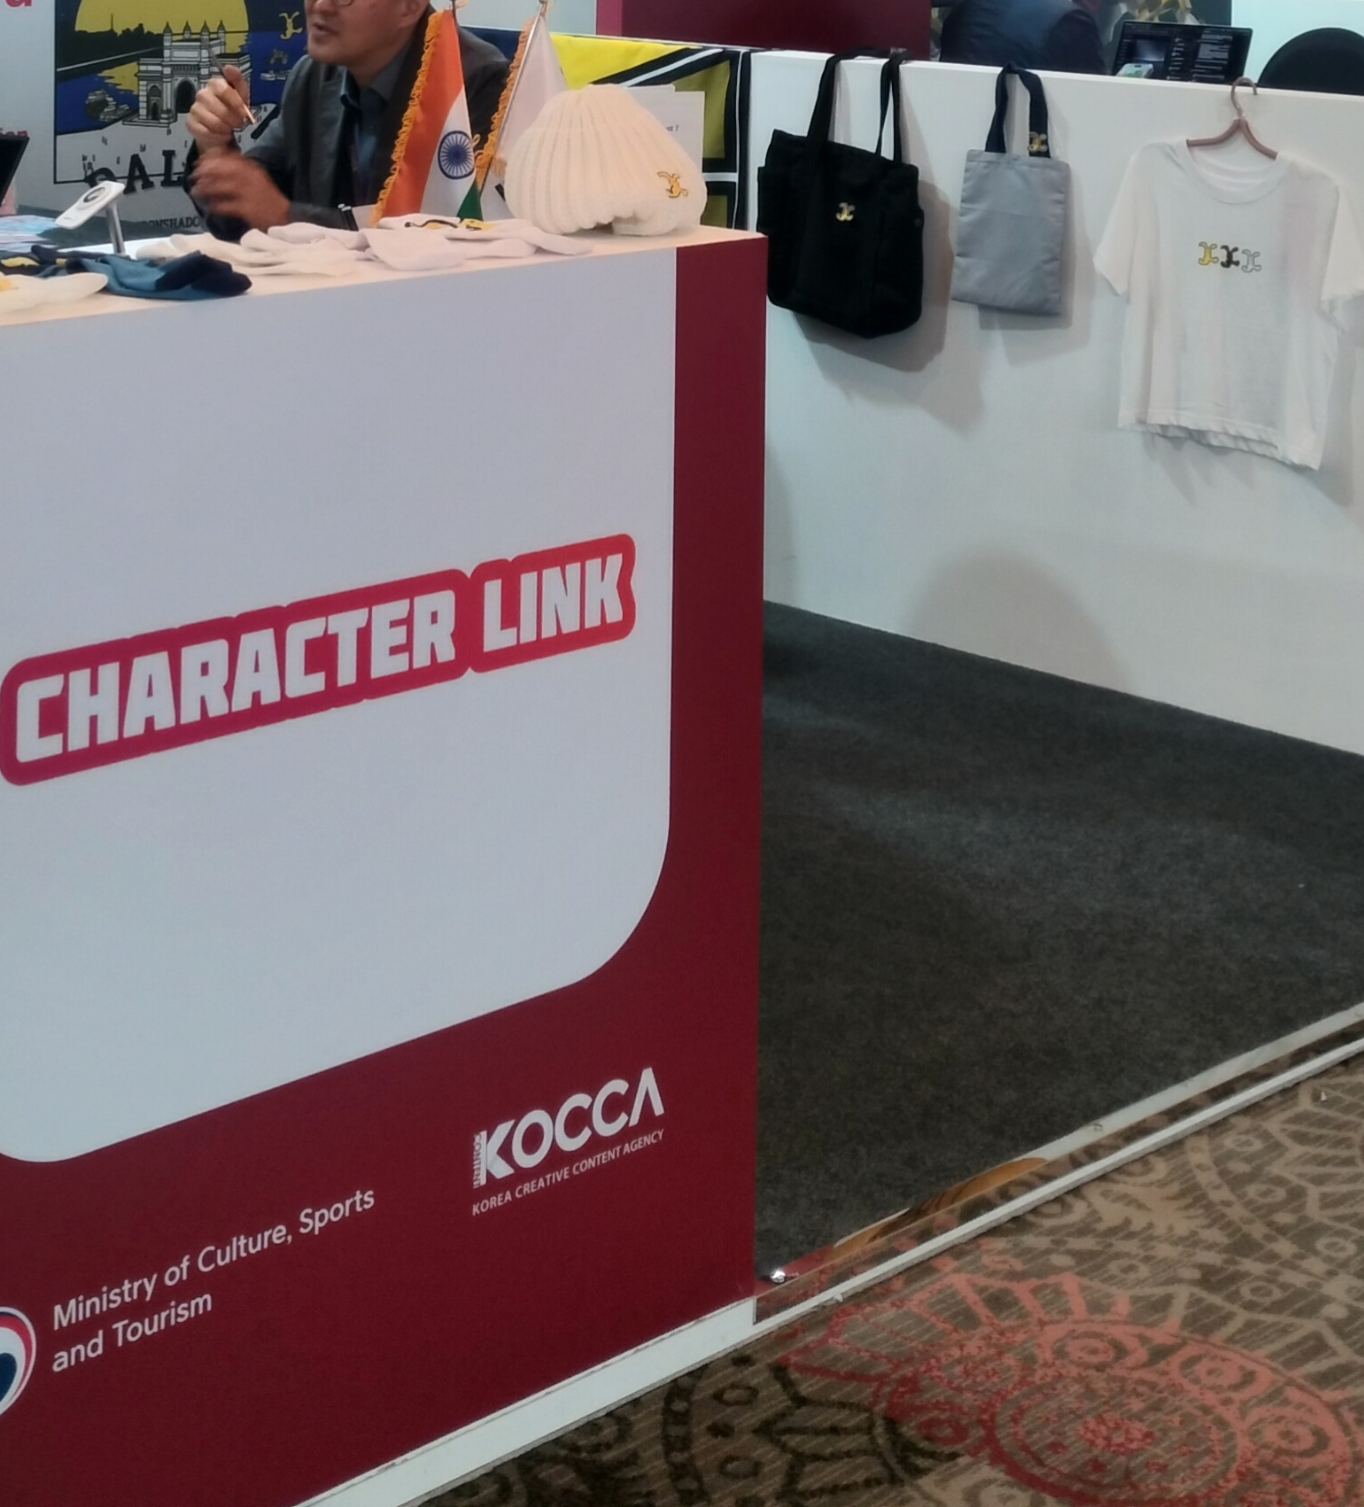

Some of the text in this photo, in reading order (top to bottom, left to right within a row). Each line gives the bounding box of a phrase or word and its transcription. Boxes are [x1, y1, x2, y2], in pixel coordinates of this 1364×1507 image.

[15, 552, 625, 764] CHARACTER LINK
[472, 1128, 665, 1216] KOREA CREATIVE CONTENT AGENCY
[473, 1066, 665, 1190] KOCCA
[52, 1189, 375, 1331] Ministry of Culture, Sports
[52, 1293, 212, 1373] and Tourism
